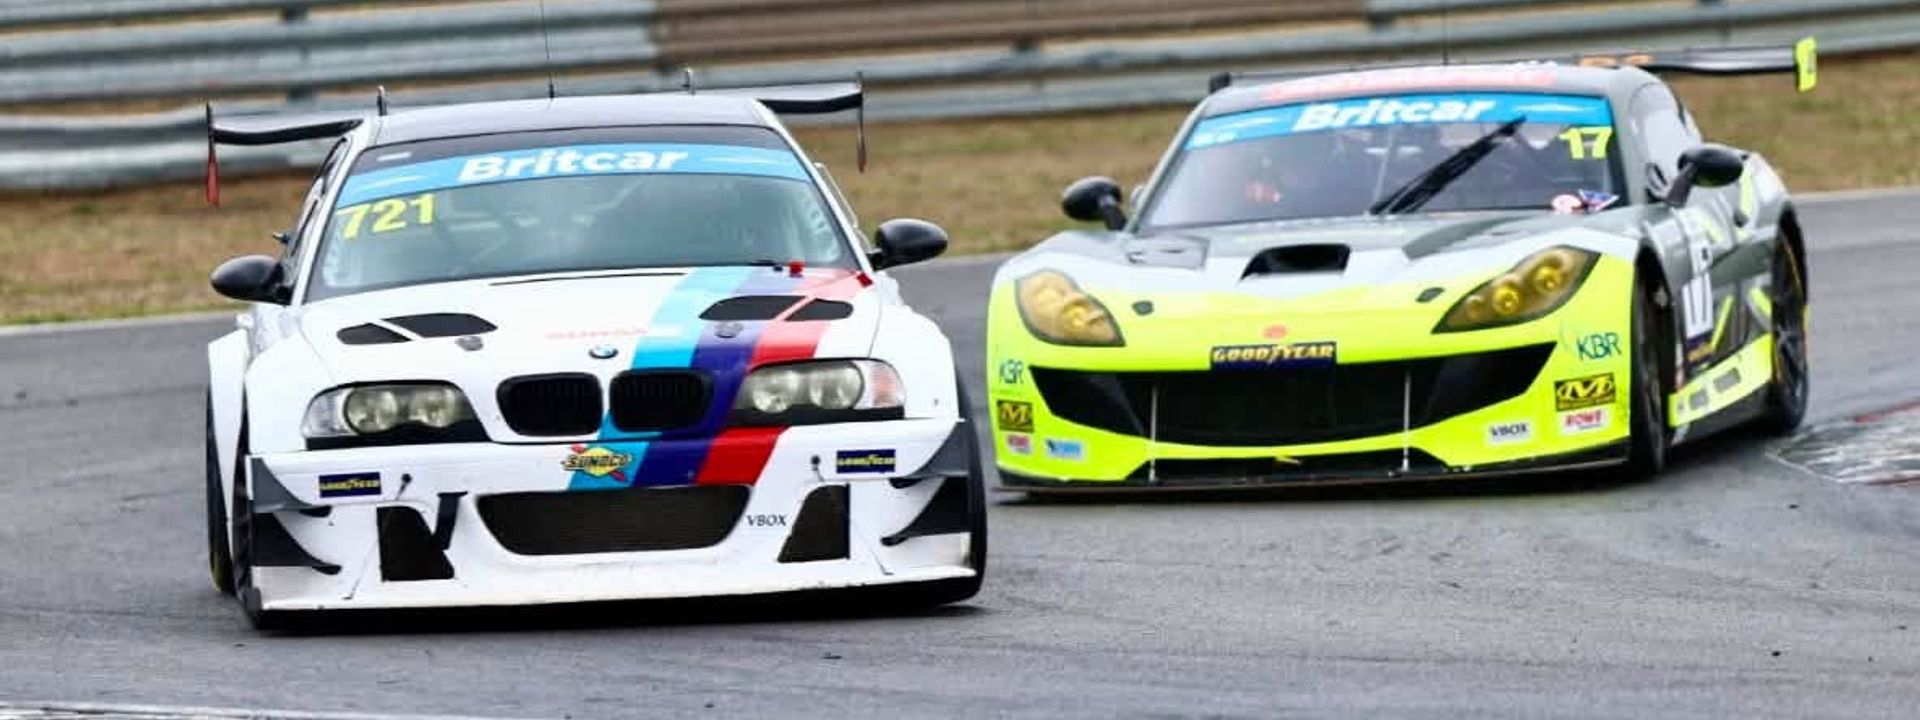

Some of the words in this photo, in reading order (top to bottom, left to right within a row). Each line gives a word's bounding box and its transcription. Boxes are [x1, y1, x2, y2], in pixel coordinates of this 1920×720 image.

[1293, 99, 1495, 131] Britcar
[1559, 127, 1612, 160] 17
[459, 149, 689, 183] Britcar
[336, 193, 436, 239] 721
[1213, 345, 1334, 364] GOODYEAR
[1577, 332, 1622, 360] KBR
[564, 453, 632, 471] SUNOCO
[747, 514, 787, 526] VBOX
